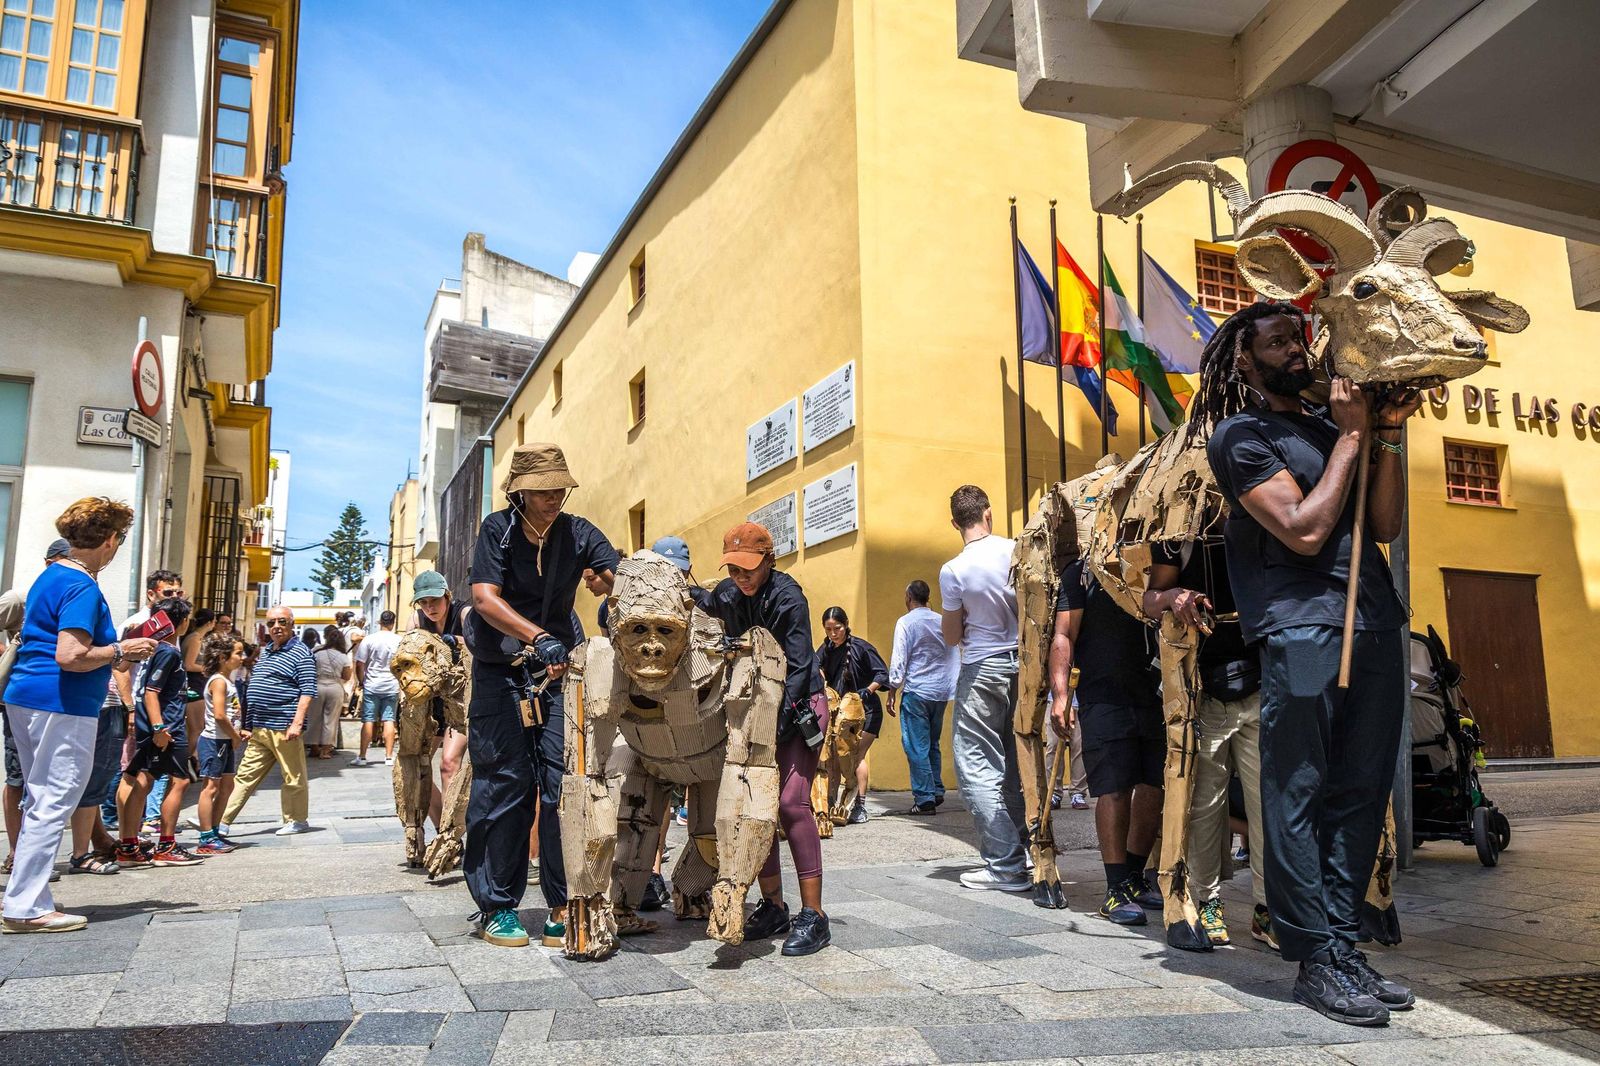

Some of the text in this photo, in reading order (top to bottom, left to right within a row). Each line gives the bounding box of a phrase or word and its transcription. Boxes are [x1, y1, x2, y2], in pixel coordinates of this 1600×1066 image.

[1463, 384, 1502, 413] DE
[1512, 392, 1560, 423] LAS
[82, 425, 104, 437] Las
